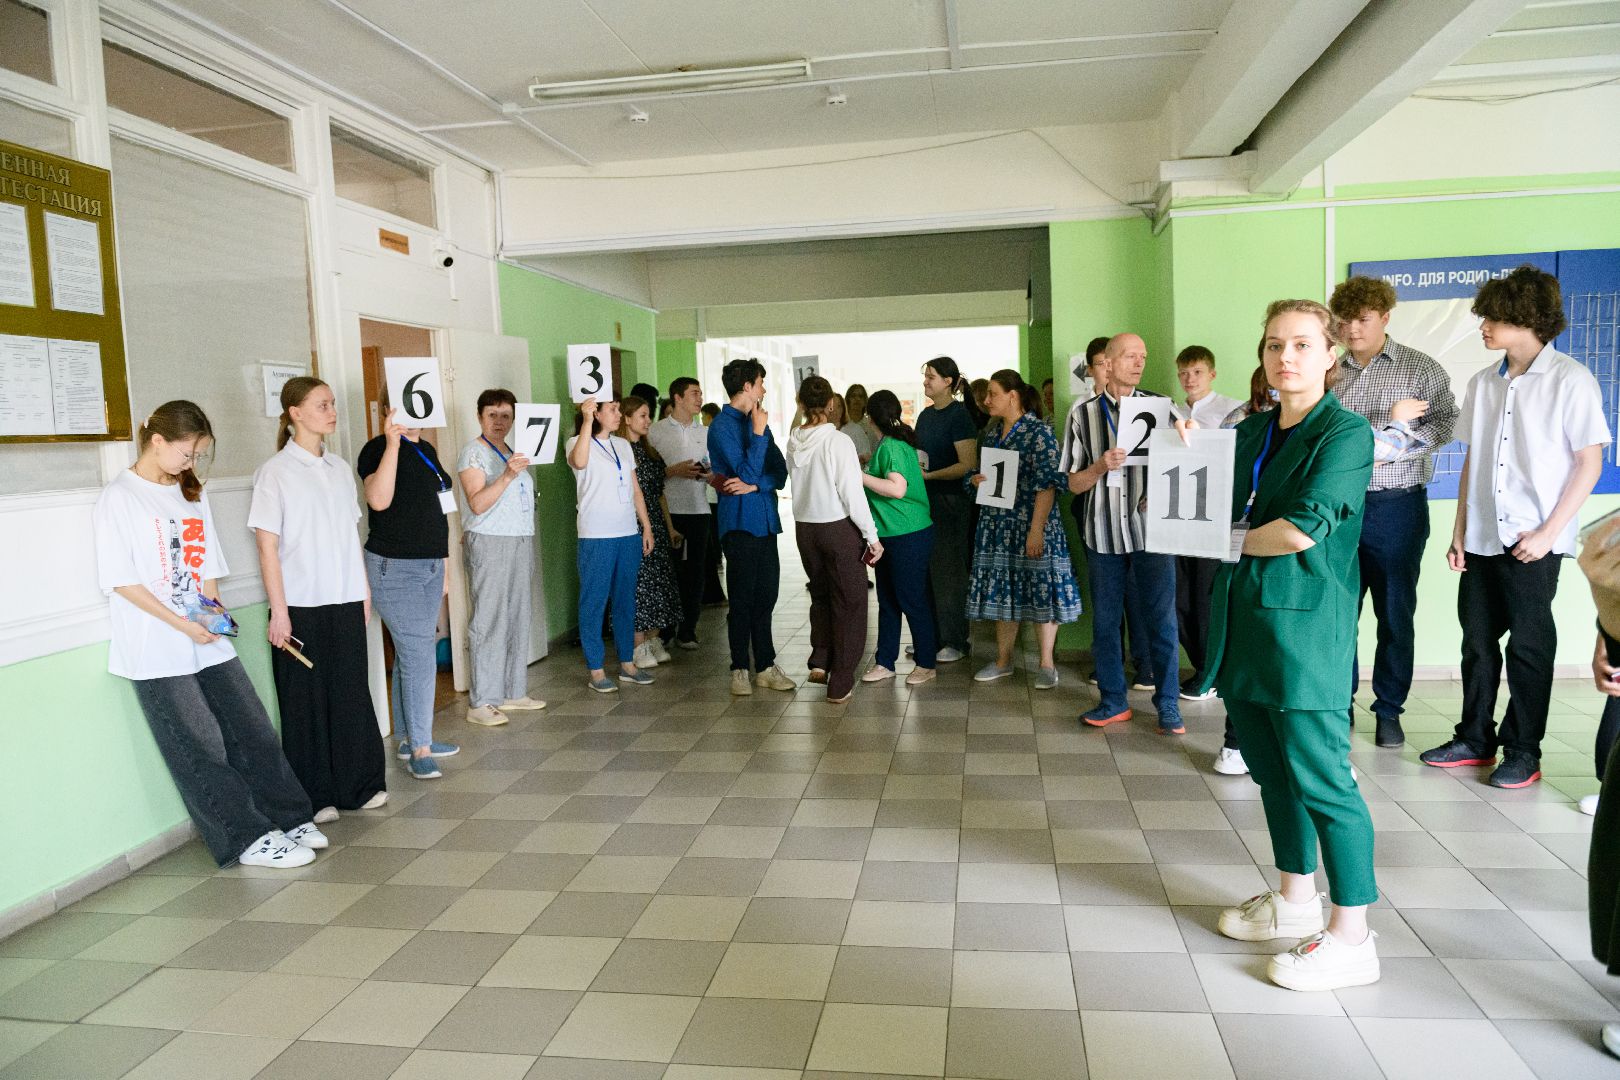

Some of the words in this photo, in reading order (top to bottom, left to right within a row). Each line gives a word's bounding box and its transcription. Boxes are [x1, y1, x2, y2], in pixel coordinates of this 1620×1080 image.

[1418, 272, 1445, 287] ДЛЯ
[402, 371, 434, 419] 6
[580, 355, 603, 395] 3
[526, 417, 552, 457] 7
[1127, 411, 1157, 457] 2
[987, 460, 1006, 500] 1
[1161, 465, 1213, 522] 11
